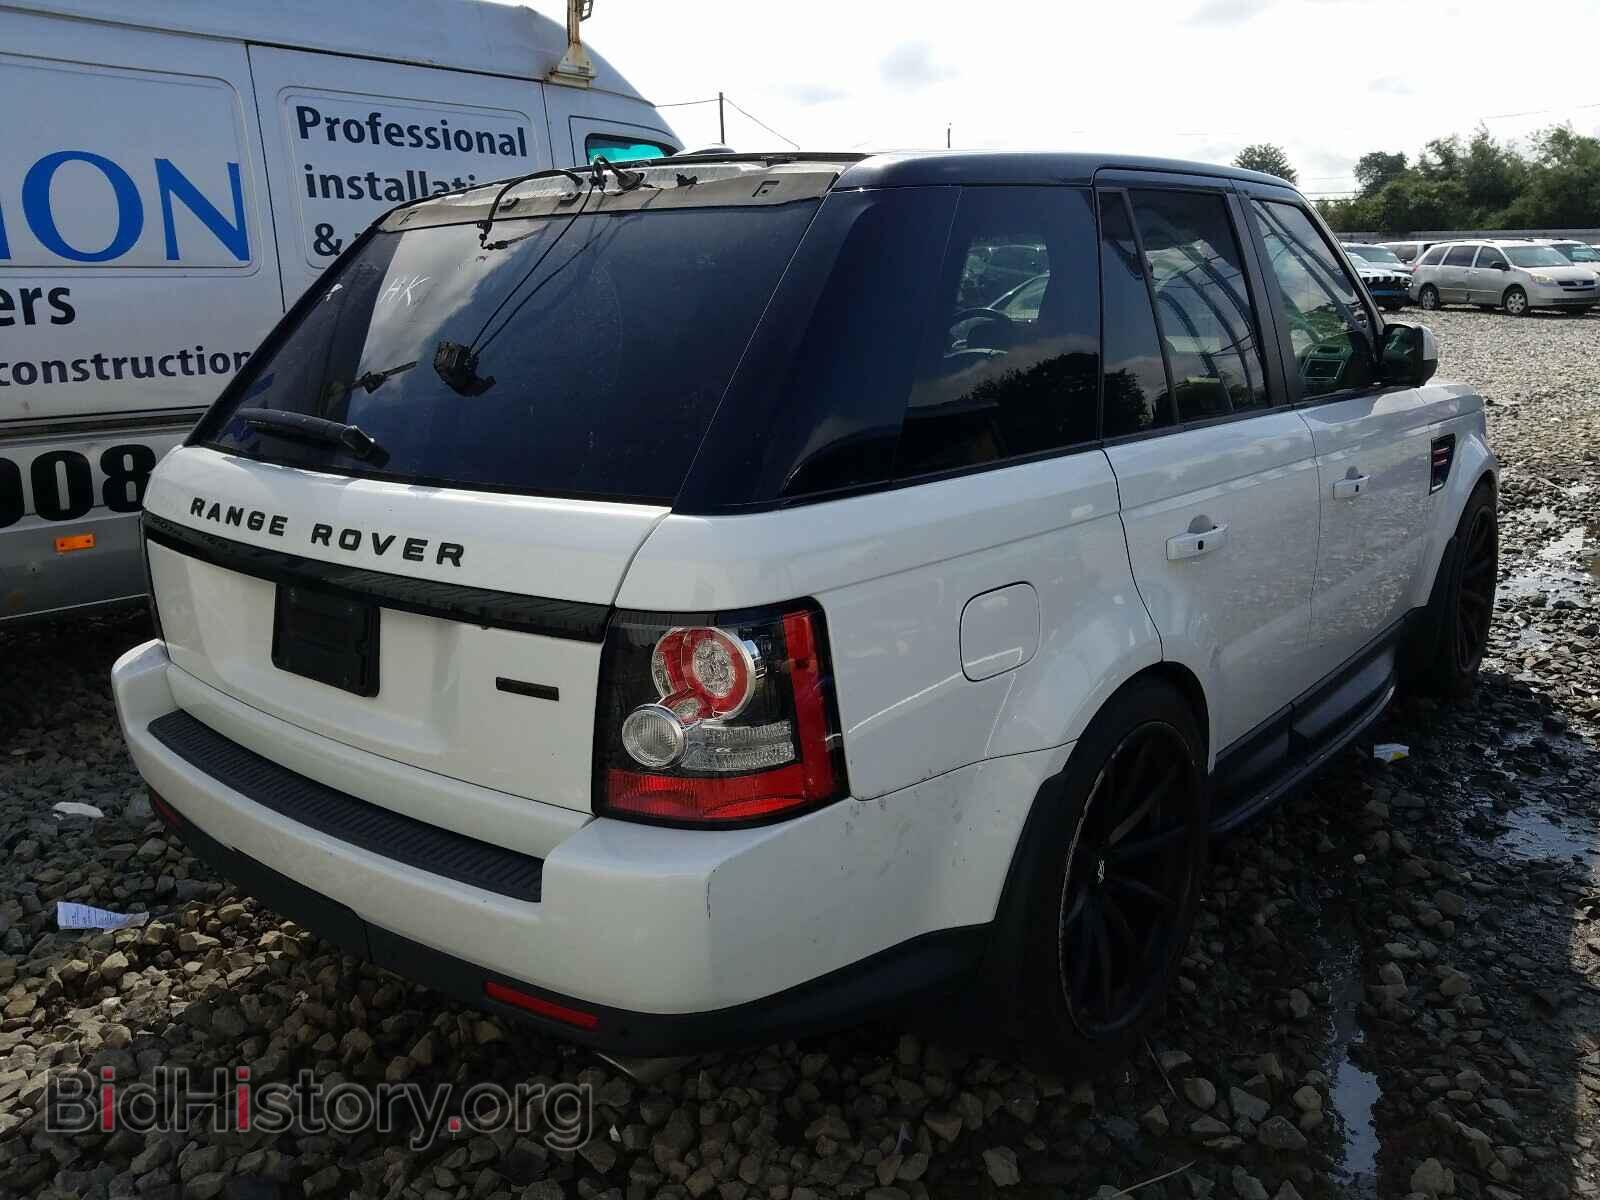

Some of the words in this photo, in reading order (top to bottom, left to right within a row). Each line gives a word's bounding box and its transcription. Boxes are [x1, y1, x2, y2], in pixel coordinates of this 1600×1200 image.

[296, 105, 528, 157] Professional
[0, 150, 250, 262] ON
[313, 223, 343, 256] &
[190, 497, 288, 536] RANGE
[310, 523, 464, 567] ROVER
